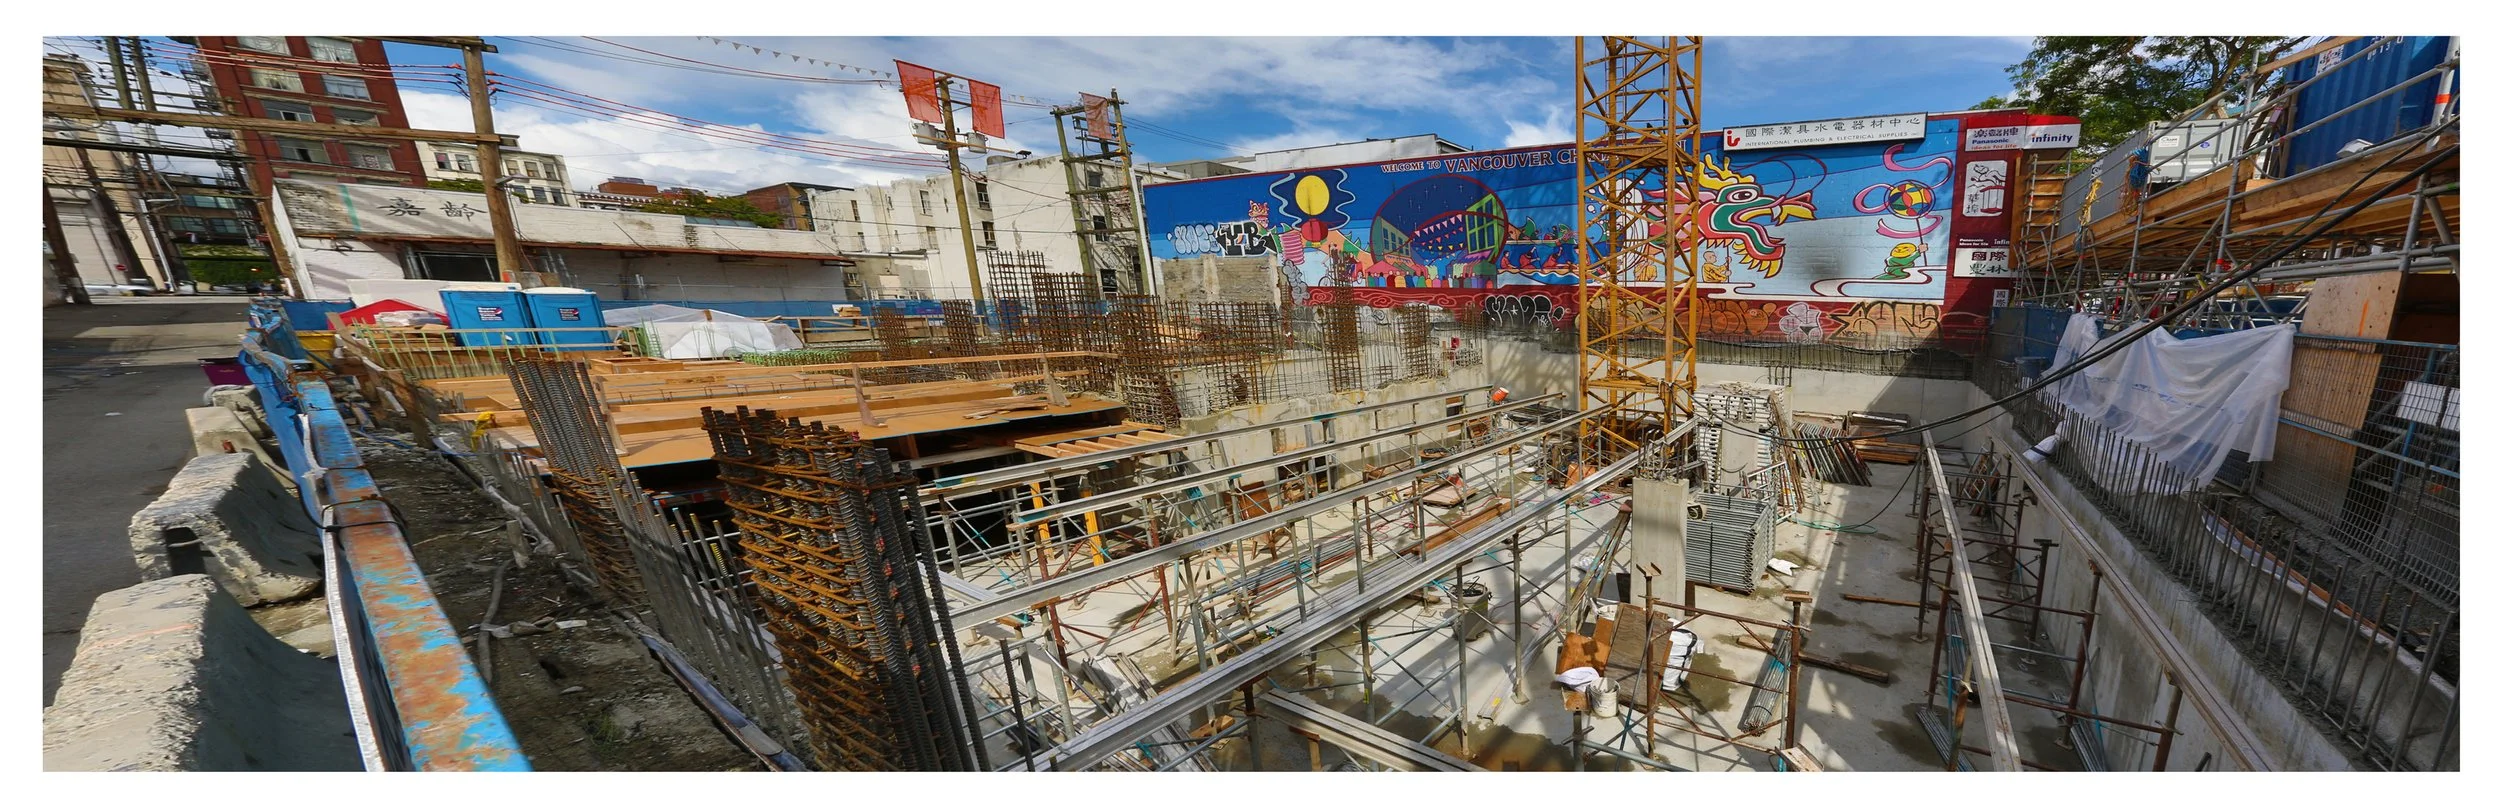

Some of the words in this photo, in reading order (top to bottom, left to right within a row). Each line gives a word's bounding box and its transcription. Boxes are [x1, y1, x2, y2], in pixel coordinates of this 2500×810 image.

[2031, 132, 2073, 143] infinity
[1381, 161, 1424, 173] WELCOME
[1427, 160, 1441, 170] TO
[1444, 150, 1553, 174] VANCOUVER
